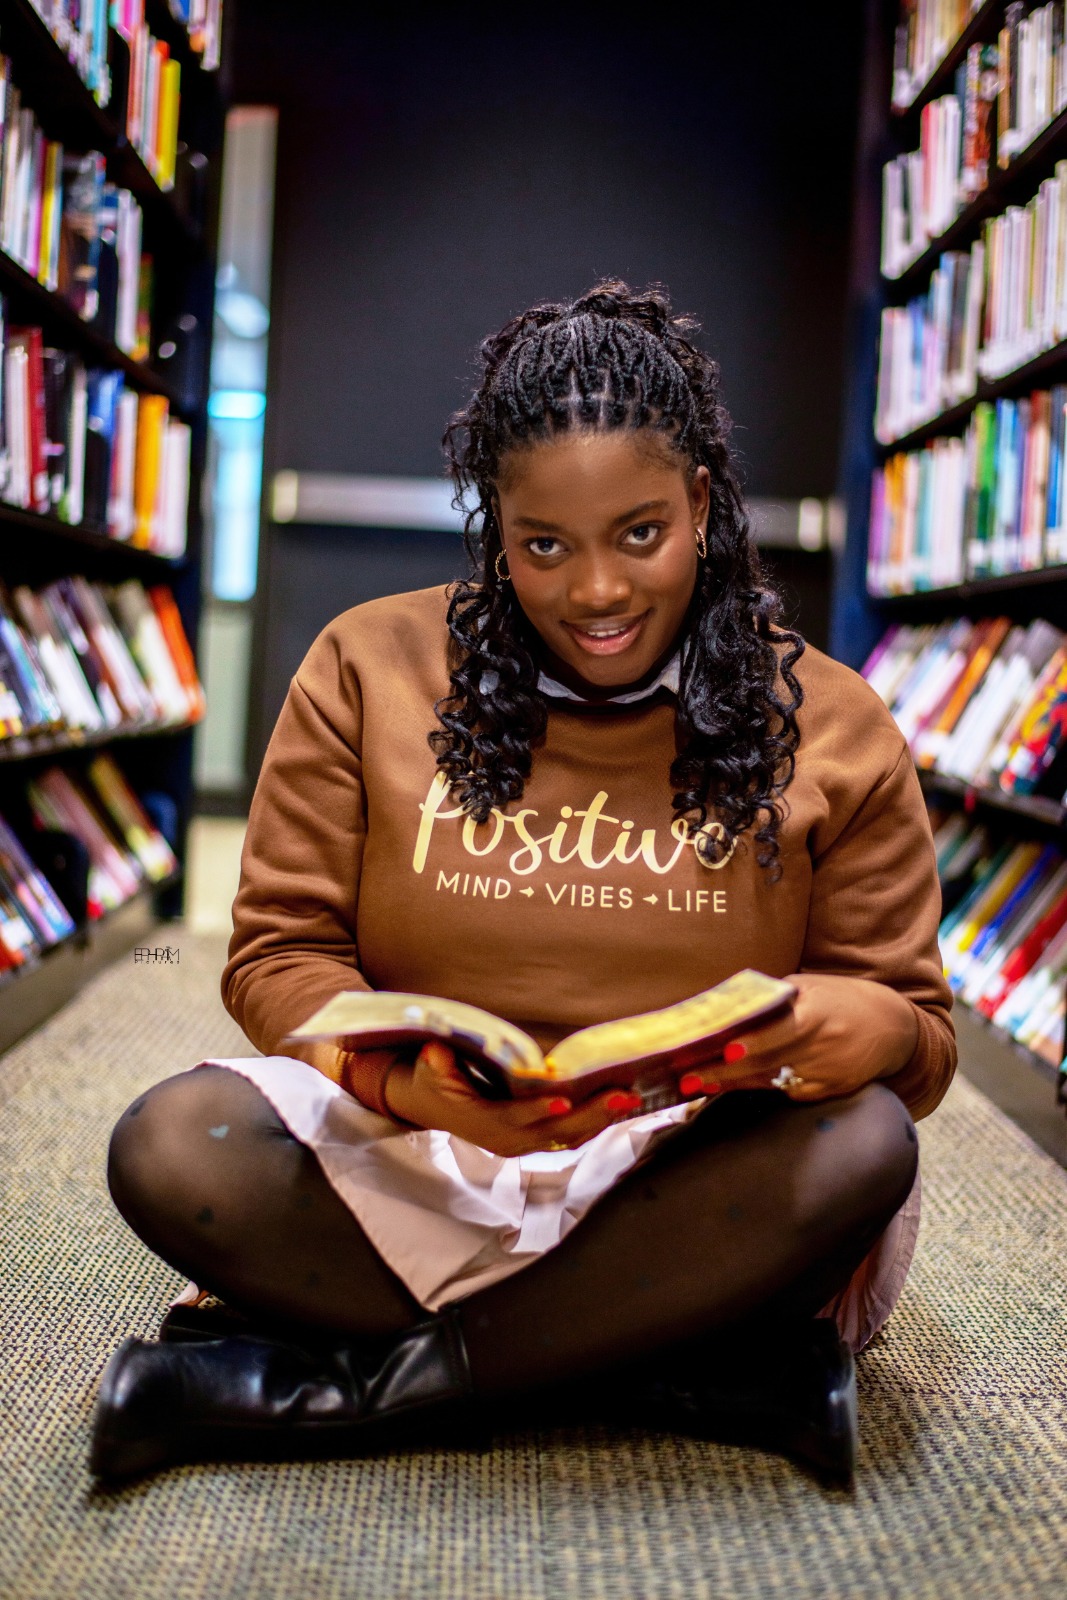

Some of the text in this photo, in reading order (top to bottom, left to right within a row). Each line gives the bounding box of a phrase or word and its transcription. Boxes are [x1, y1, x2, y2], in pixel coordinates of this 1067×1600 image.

[436, 870, 727, 913] MIND VIBES LIFE
